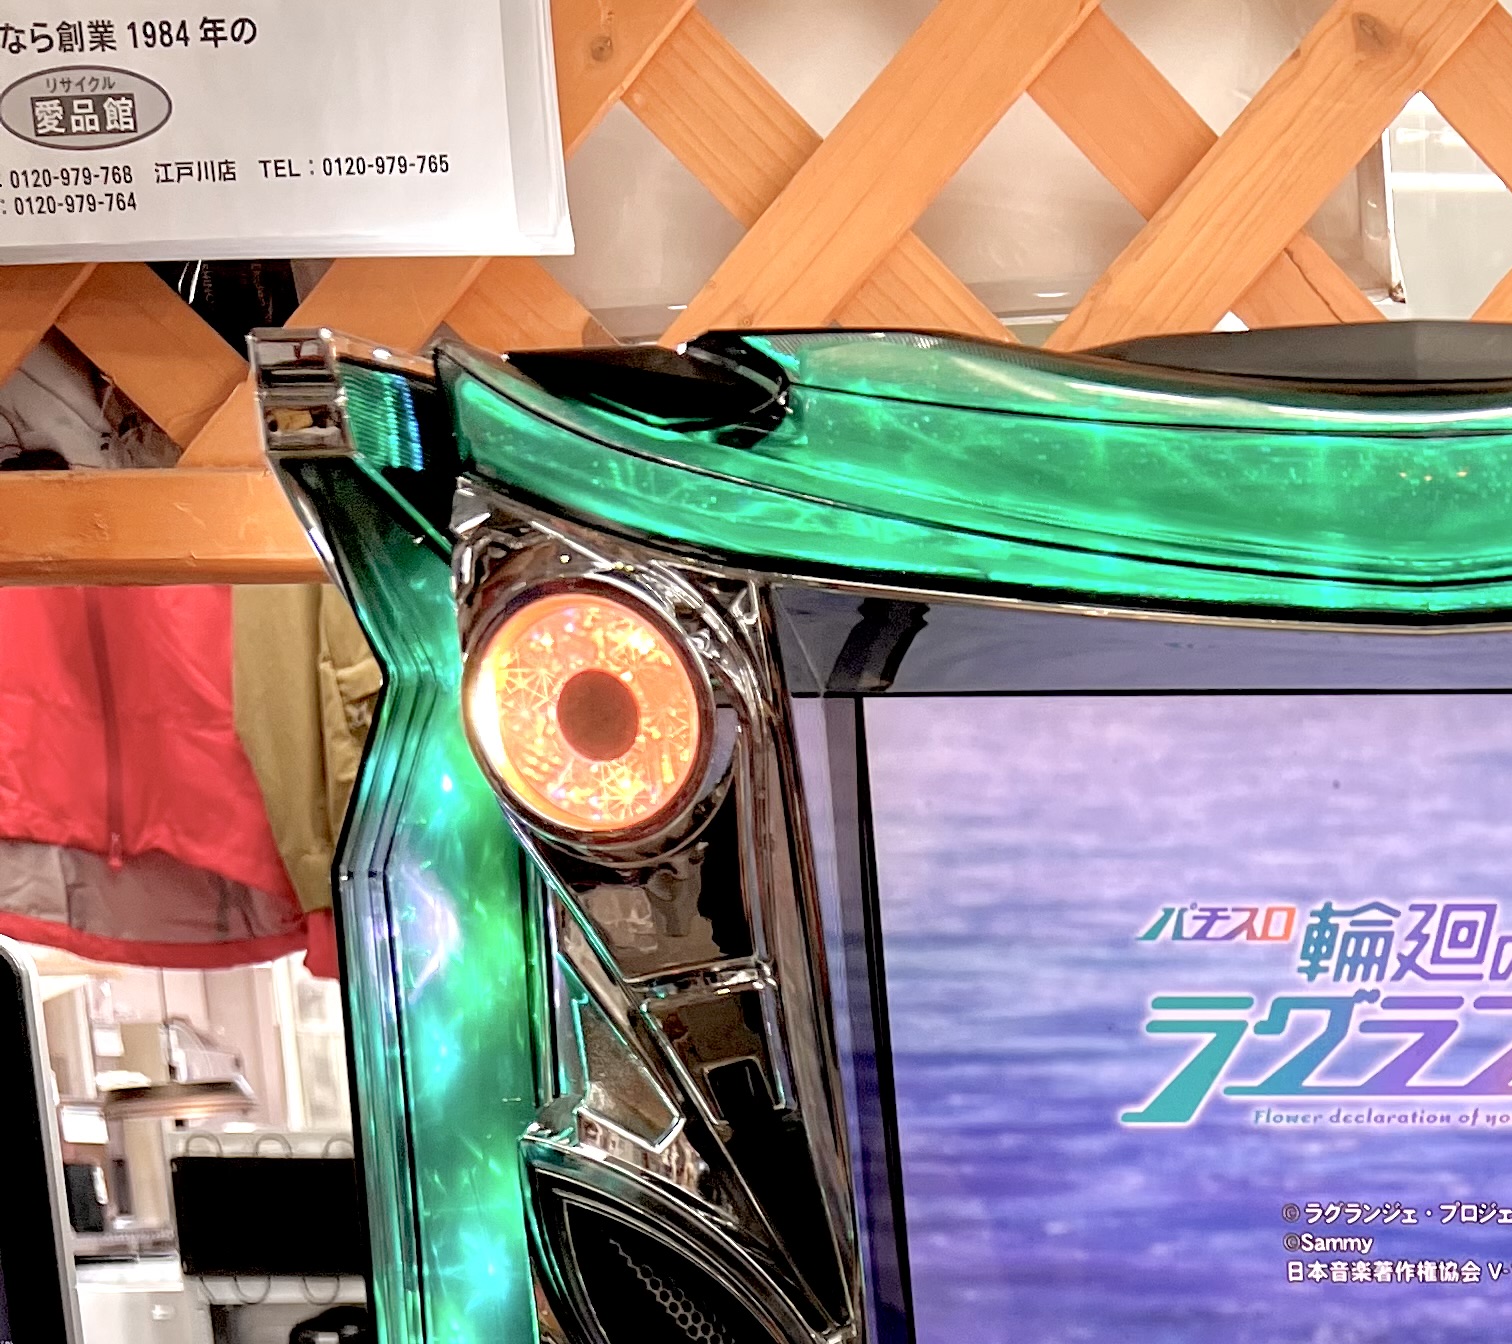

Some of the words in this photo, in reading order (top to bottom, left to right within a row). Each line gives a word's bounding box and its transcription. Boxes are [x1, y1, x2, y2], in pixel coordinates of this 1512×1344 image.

[127, 20, 190, 49] 1984
[199, 17, 257, 47] 年の
[45, 76, 116, 93] リサイクル
[34, 97, 135, 133] 愛品館
[155, 160, 237, 184] 江戸川店
[1136, 901, 1296, 942] パチスロ
[1254, 1109, 1323, 1126] Flower
[1329, 1109, 1451, 1126] declaration
[1458, 1107, 1481, 1127] of
[1287, 1261, 1481, 1283] 日本音楽著作権協会
